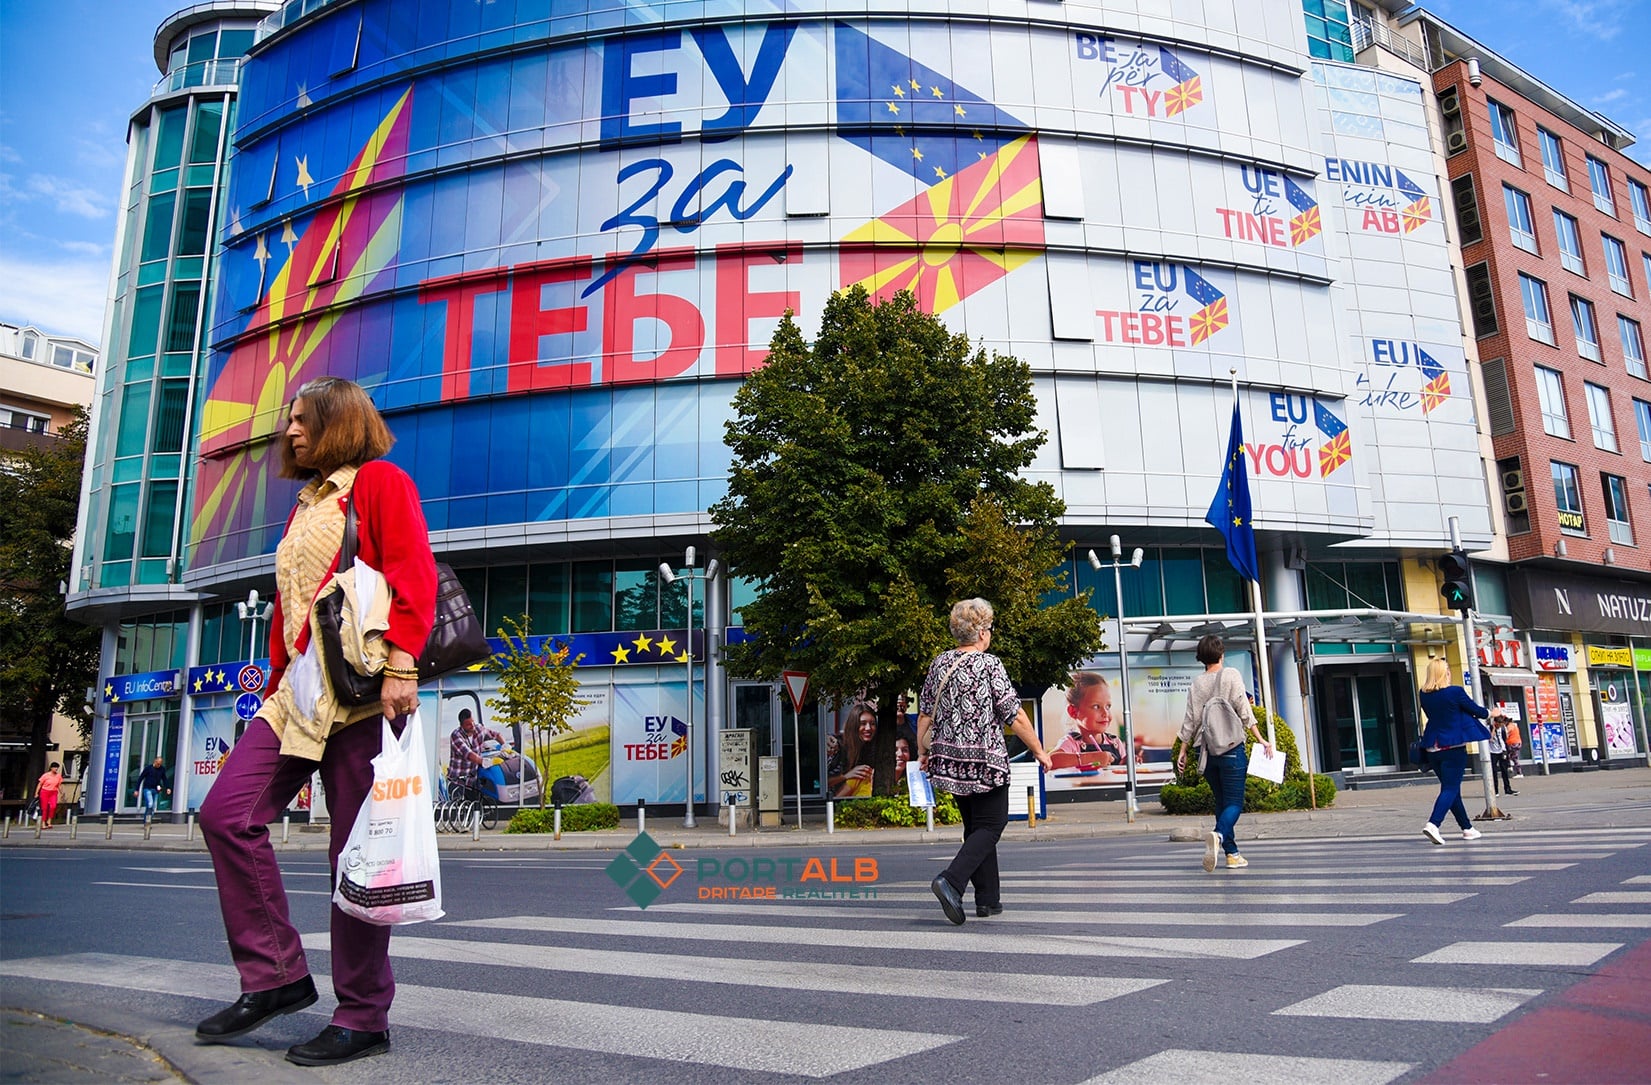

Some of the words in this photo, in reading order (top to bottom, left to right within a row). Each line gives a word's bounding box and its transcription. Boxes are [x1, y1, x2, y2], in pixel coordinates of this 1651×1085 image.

[600, 22, 800, 151] ЕУ
[1115, 84, 1161, 117] TY
[1241, 164, 1281, 198] UE
[1251, 193, 1278, 216] ti
[1362, 205, 1401, 233] AB
[581, 158, 794, 299] за
[1215, 207, 1287, 247] TINE
[1133, 260, 1178, 293] EU
[1138, 294, 1179, 312] za
[418, 240, 803, 404] ТЕБЕ
[1095, 310, 1186, 348] TEBE
[1372, 339, 1409, 368] EU
[1269, 391, 1308, 425] EU
[1281, 425, 1313, 455] for
[1245, 443, 1313, 479] YOU
[1558, 511, 1583, 528] НОТАР
[1554, 587, 1572, 616] N
[124, 680, 136, 695] EU
[645, 716, 668, 733] ЕУ
[205, 737, 218, 751] ЕУ
[624, 743, 669, 761] ТЕБЕ
[645, 733, 668, 748] за
[194, 760, 216, 775] ТЕБЕ
